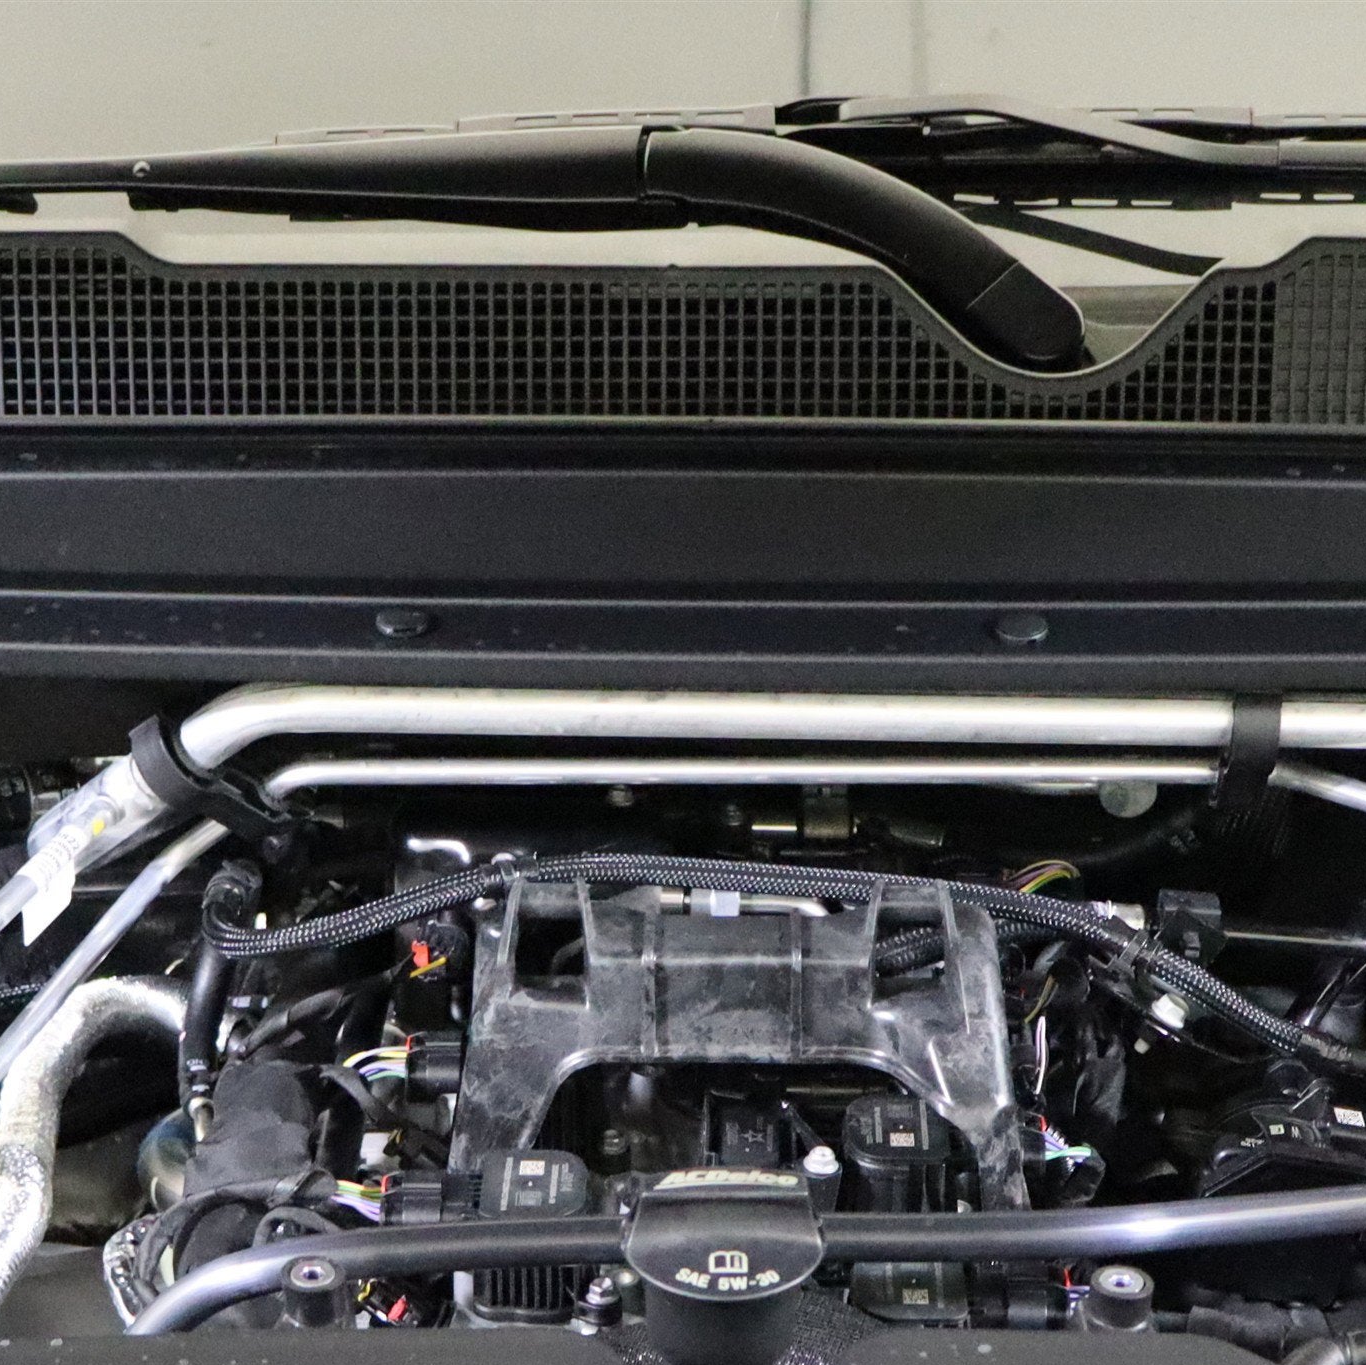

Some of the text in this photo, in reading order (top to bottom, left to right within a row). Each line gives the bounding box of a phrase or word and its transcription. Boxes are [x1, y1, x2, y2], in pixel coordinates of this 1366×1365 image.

[657, 1170, 798, 1187] ACDelco
[675, 1267, 781, 1291] SAE 5W-30
